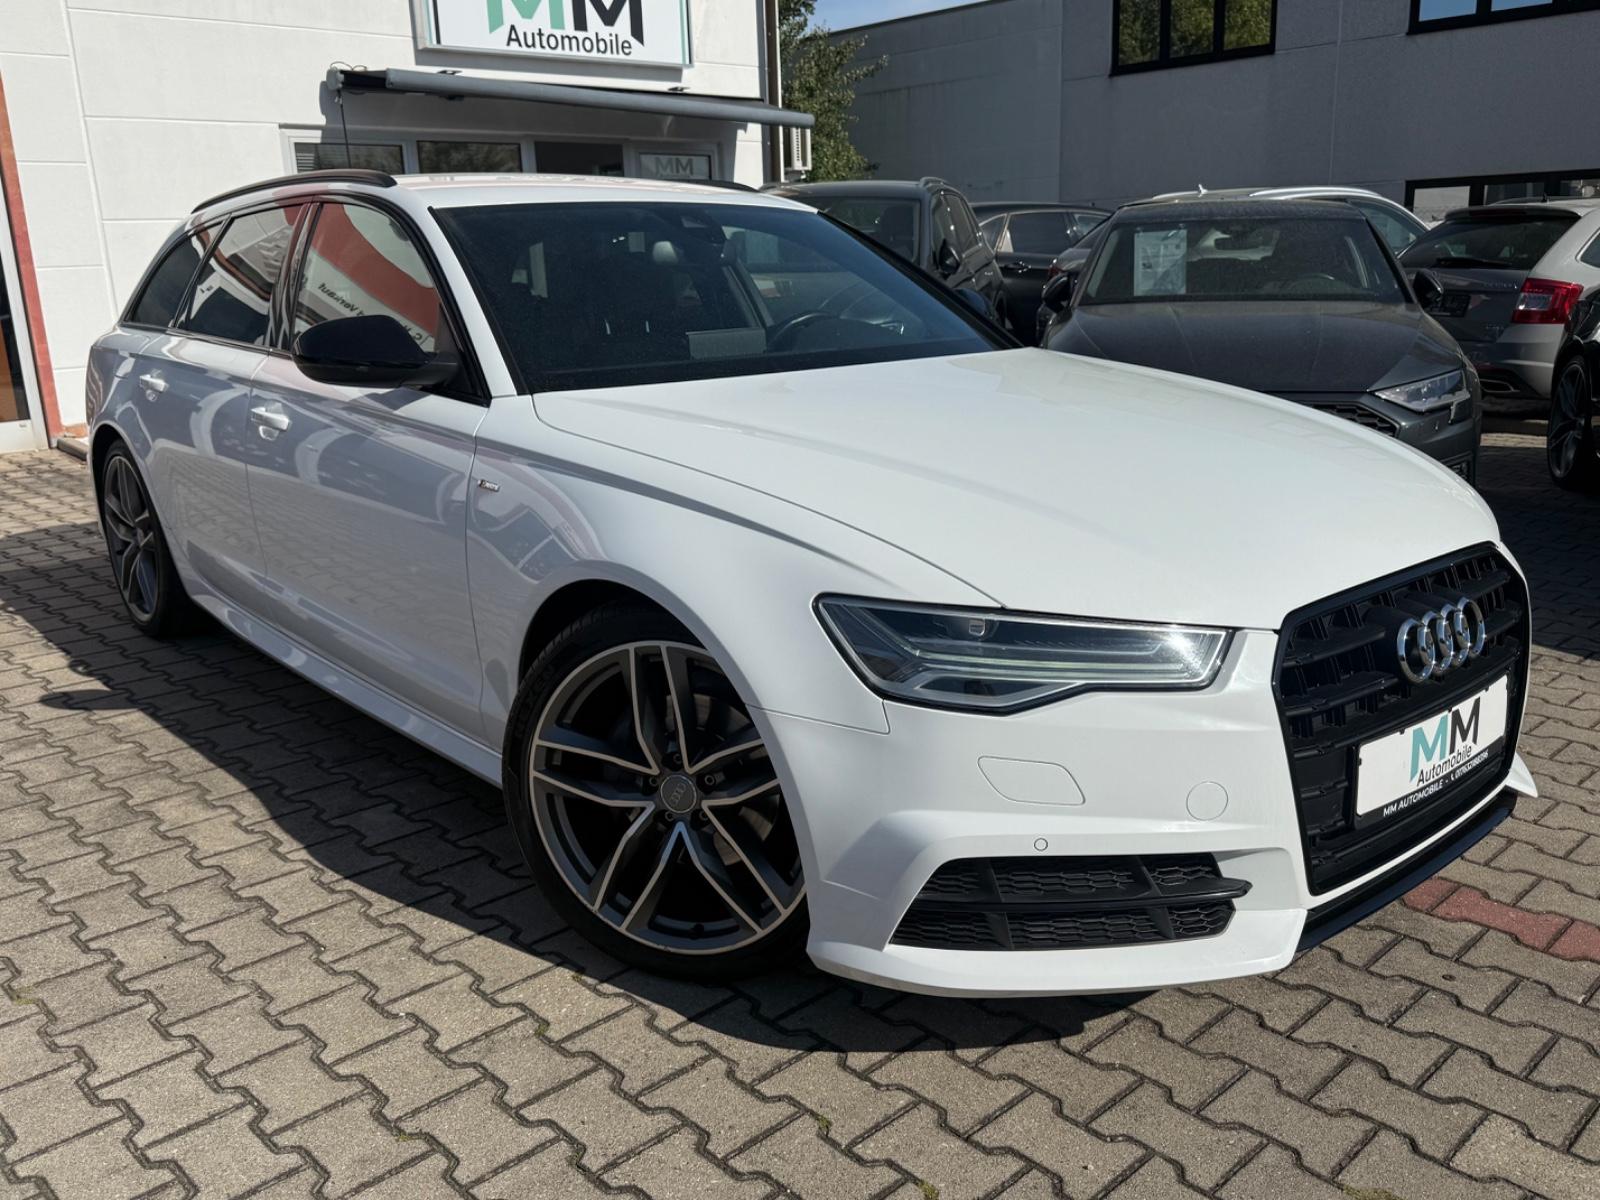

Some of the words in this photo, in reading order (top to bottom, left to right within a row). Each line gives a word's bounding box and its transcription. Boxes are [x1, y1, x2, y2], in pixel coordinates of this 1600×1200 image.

[506, 24, 633, 56] Automobile
[655, 157, 694, 177] MM
[1410, 697, 1481, 783] MM
[1416, 745, 1472, 787] Automobile
[1383, 803, 1397, 817] MM
[1398, 779, 1444, 809] AUTOMOBILE
